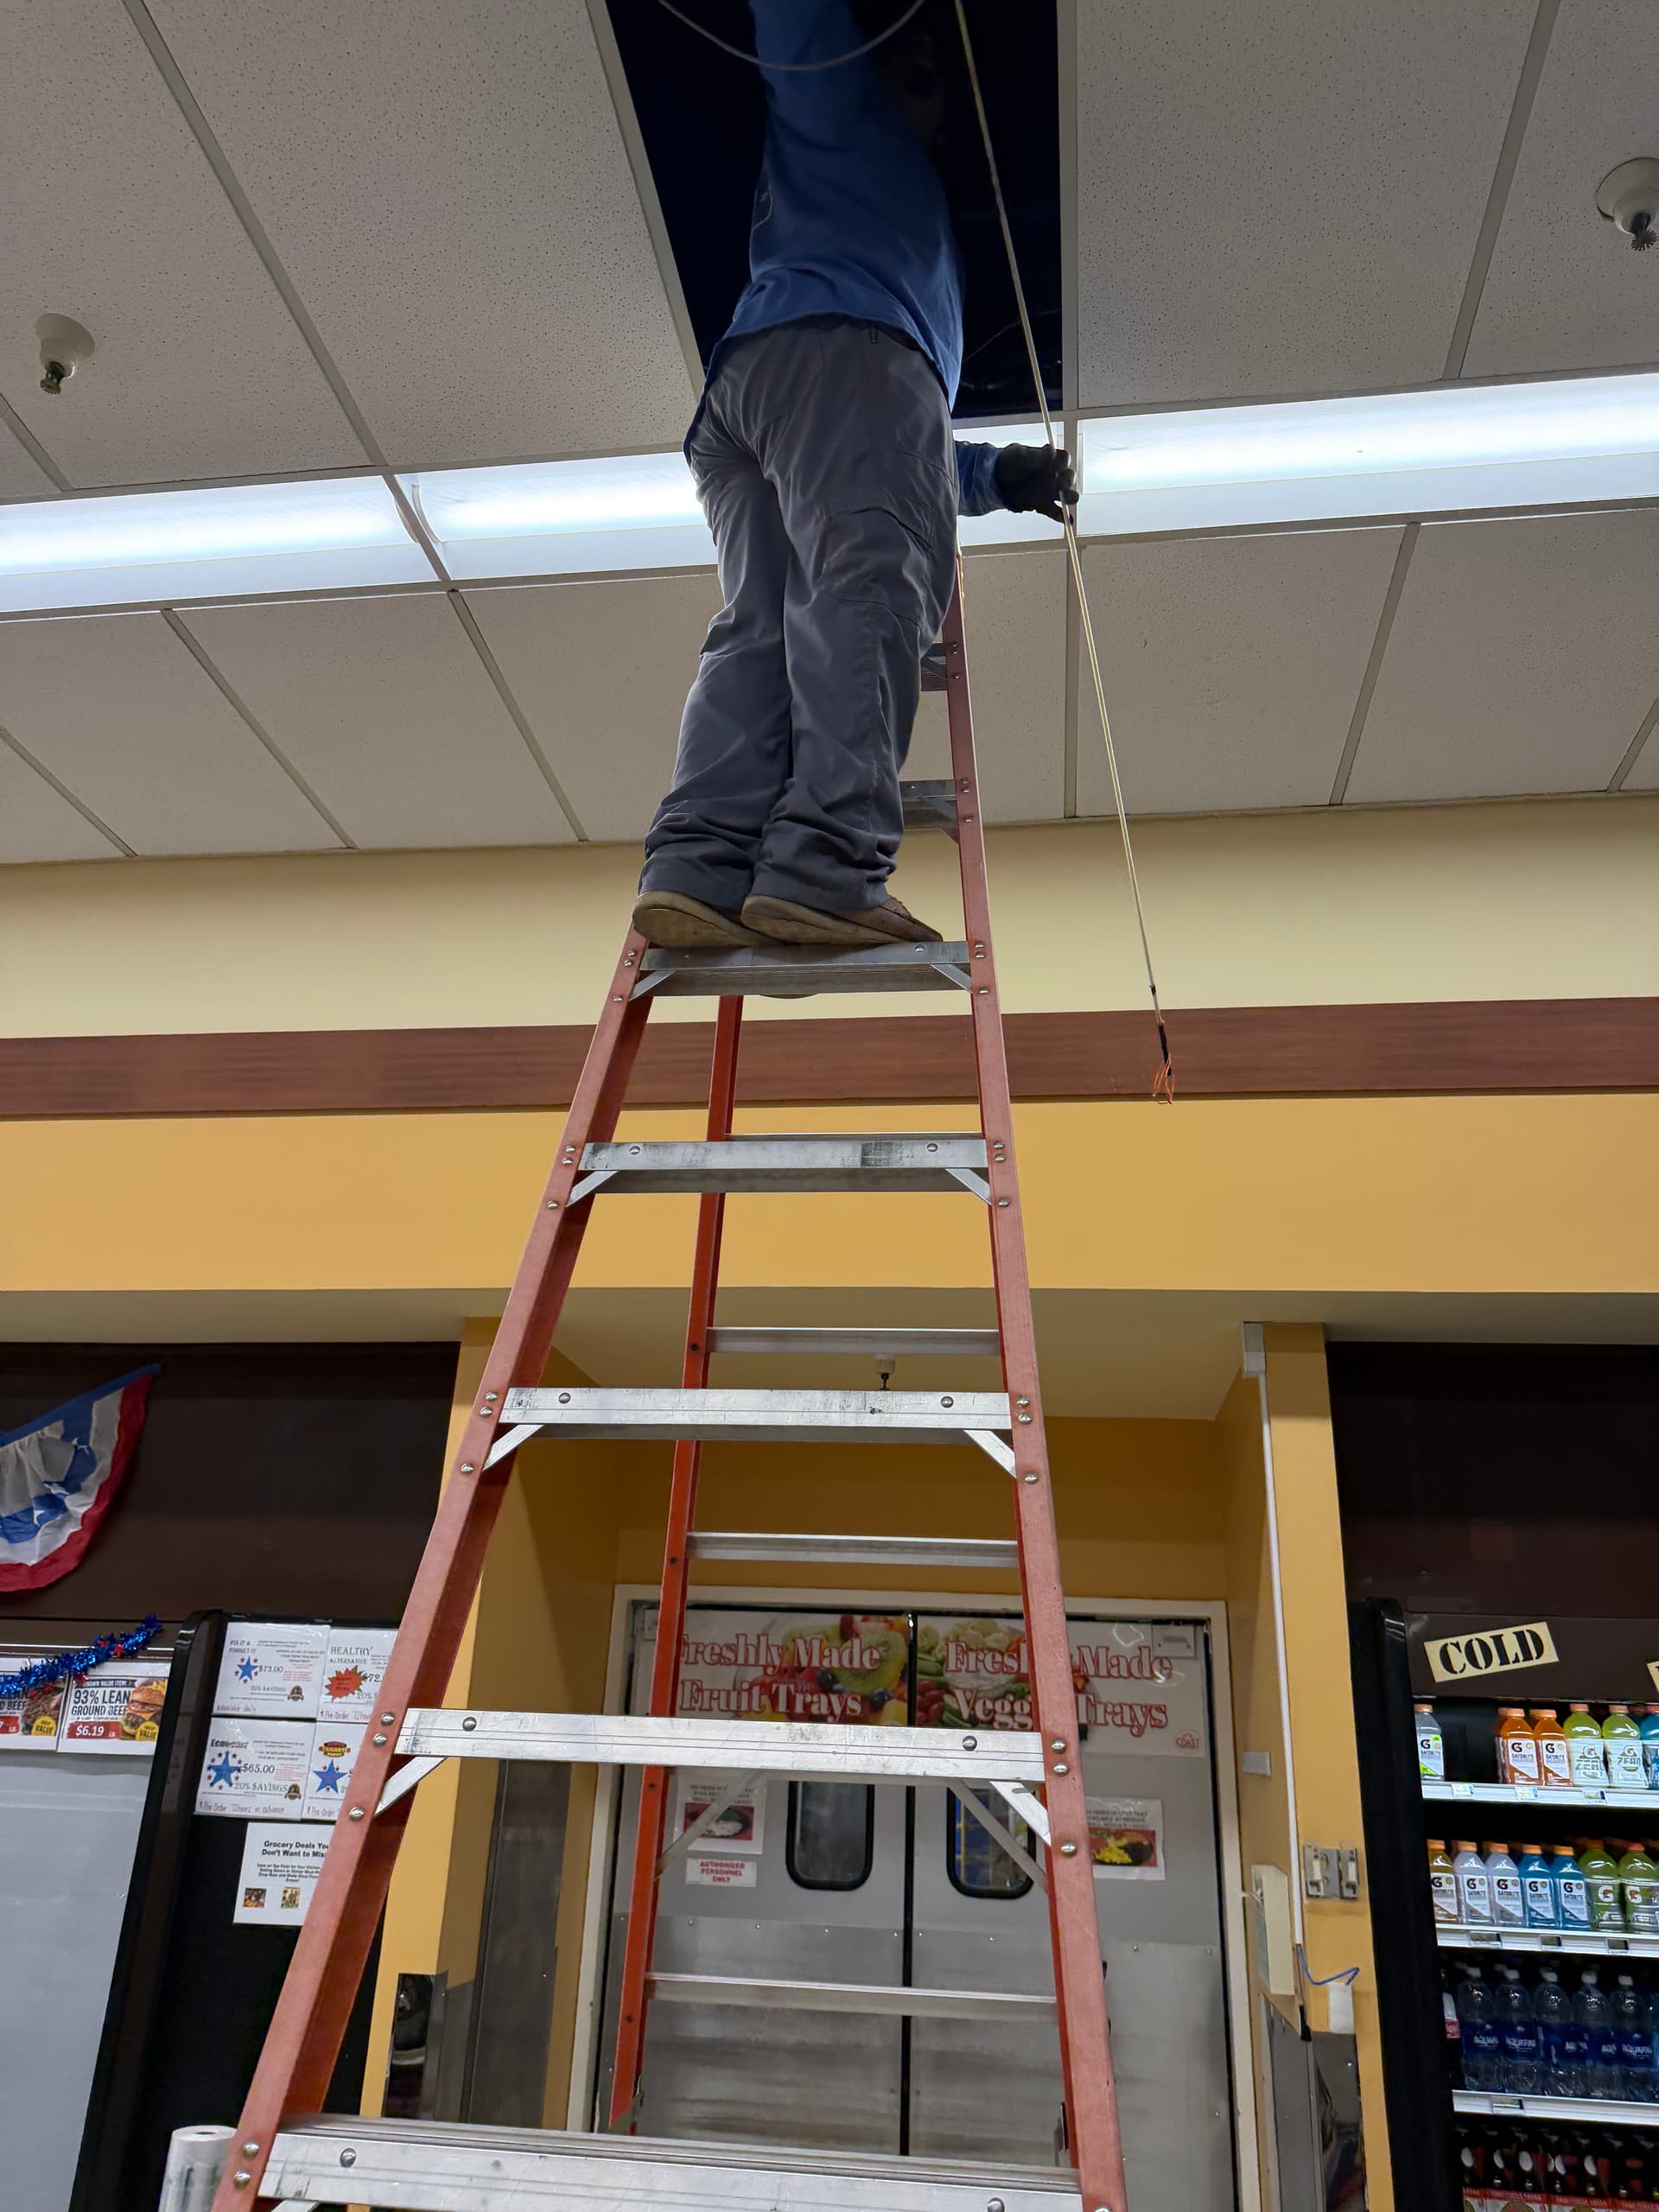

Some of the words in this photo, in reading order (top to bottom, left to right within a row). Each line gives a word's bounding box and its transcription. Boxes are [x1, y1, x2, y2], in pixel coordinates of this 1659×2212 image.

[330, 1646, 373, 1656] HEALTHY
[792, 1635, 881, 1670] Made
[1439, 1629, 1545, 1675] COLD
[944, 1642, 1030, 1675] Fres
[1077, 1644, 1173, 1680] Made
[73, 1689, 99, 1704] 93%
[102, 1690, 130, 1704] LEAN
[679, 1679, 772, 1713] Fruit
[772, 1681, 862, 1723] Trays
[7, 1700, 27, 1710] BEEF
[72, 1705, 105, 1716] GROUND
[108, 1706, 127, 1716] BEEF
[953, 1688, 1034, 1730] Vegg
[1077, 1694, 1168, 1738] Trays
[76, 1725, 105, 1738] $6.19
[1421, 1738, 1431, 1749] G
[1511, 1742, 1522, 1753] G
[1545, 1743, 1555, 1754] G
[241, 1763, 275, 1774] $65.00
[264, 1840, 294, 1850] Grocery
[700, 1861, 747, 1870] AUTHORIZED
[701, 1868, 742, 1877] PERSONNEL
[1431, 1877, 1443, 1888] G
[1466, 1878, 1477, 1890] G
[1497, 1878, 1509, 1890] G
[1529, 1881, 1539, 1892] G
[1563, 1882, 1573, 1893] G
[1599, 1885, 1614, 1903] G
[1625, 1885, 1643, 1904] G
